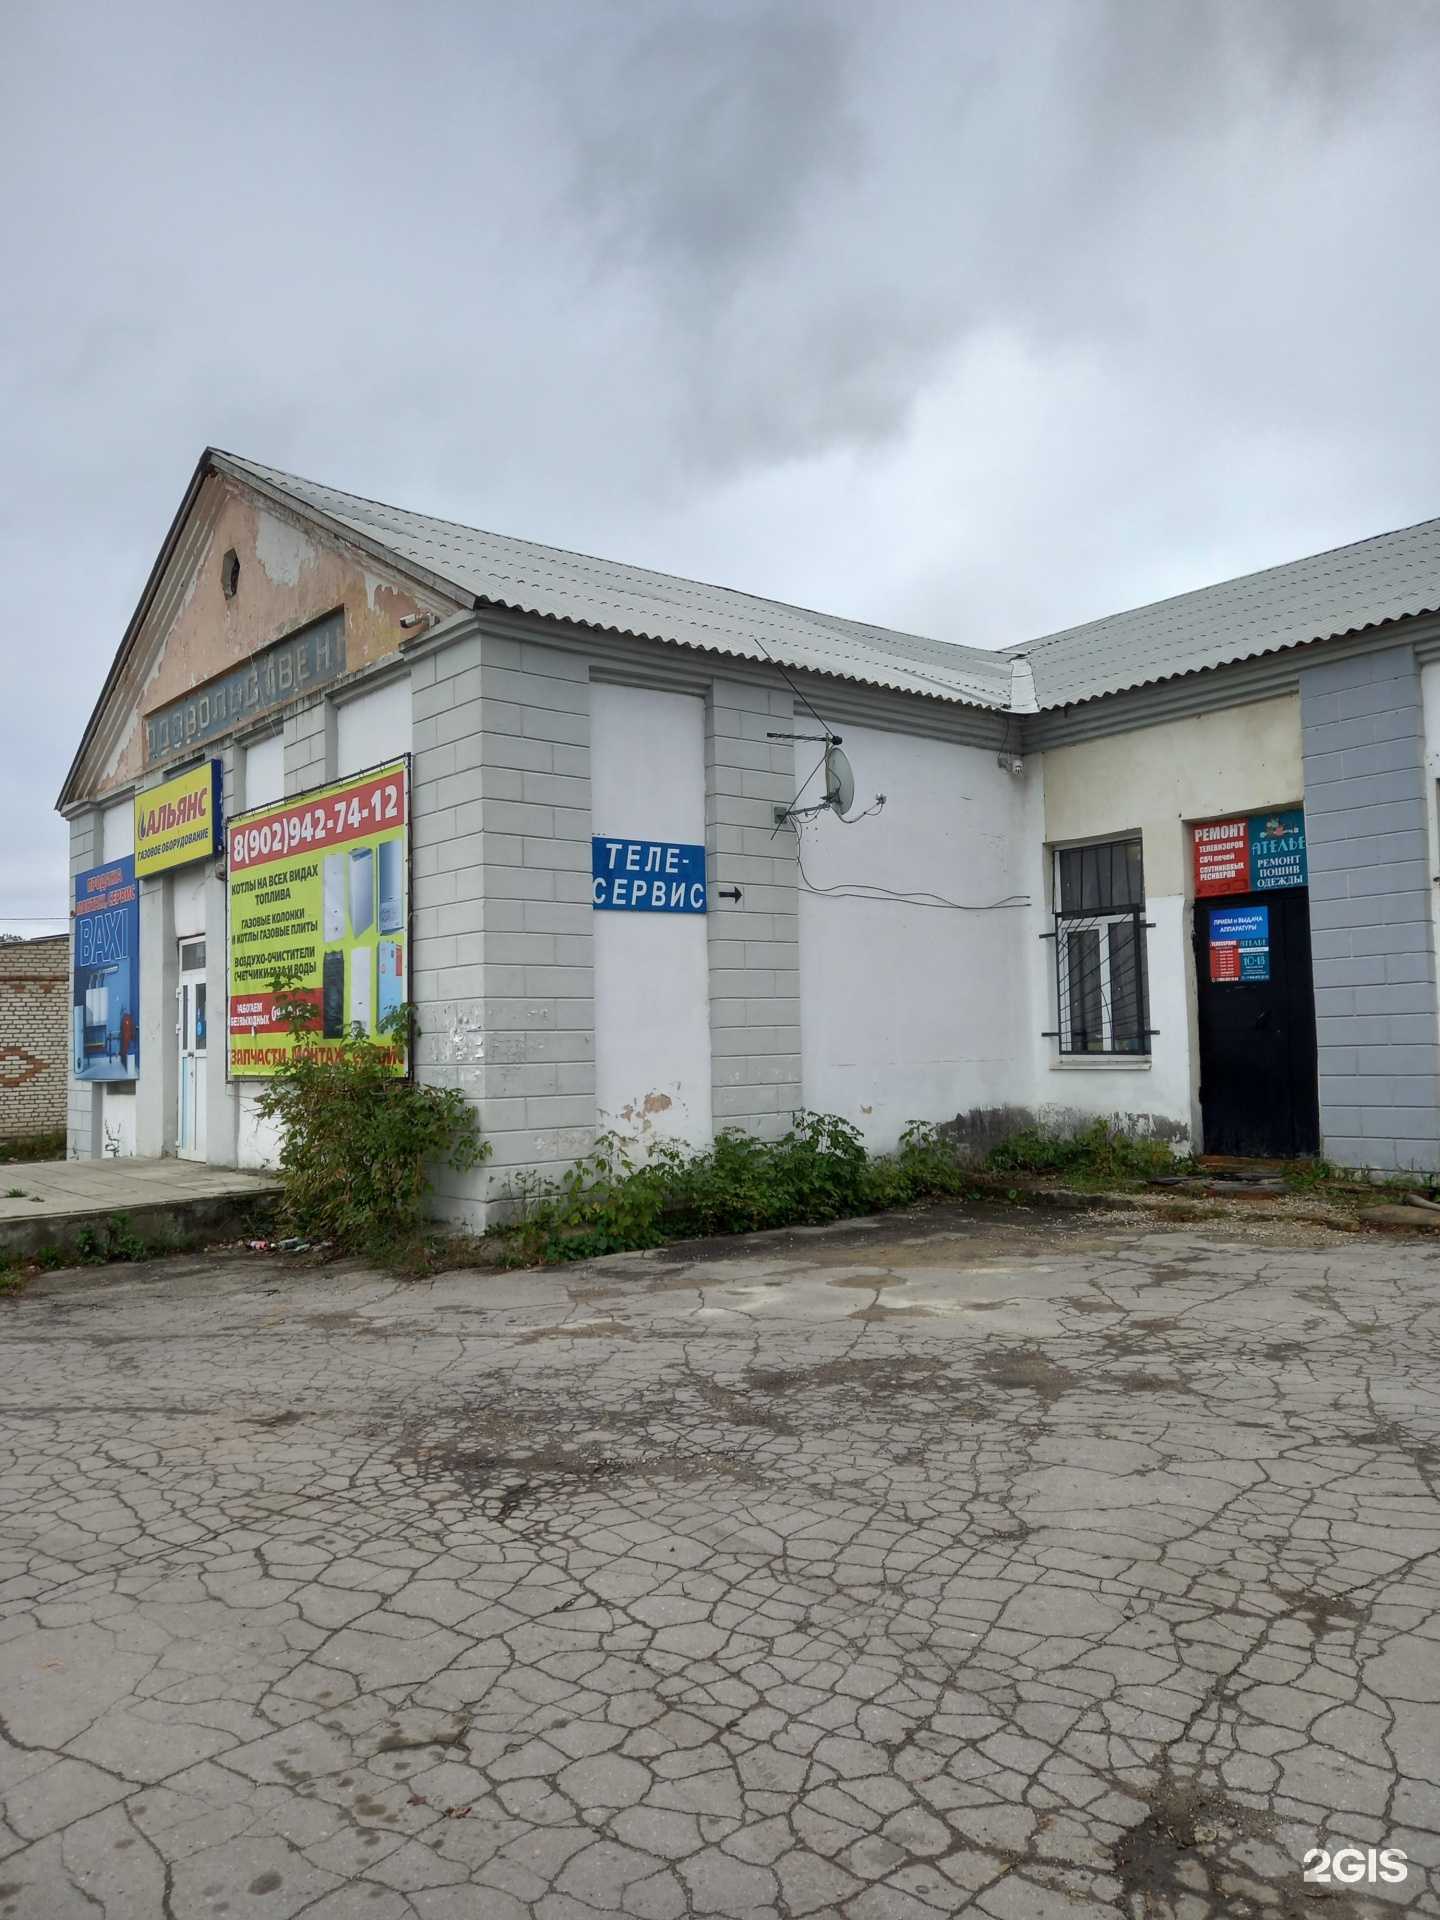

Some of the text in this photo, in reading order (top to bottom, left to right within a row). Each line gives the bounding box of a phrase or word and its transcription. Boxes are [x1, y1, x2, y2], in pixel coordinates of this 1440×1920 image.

[146, 787, 208, 837] АЛЬЯНС
[233, 784, 398, 864] 8(902)942-74-12
[1194, 822, 1246, 842] РЕМОНТ
[137, 828, 209, 861] ГАЗОВОЕ ОБОРУДОВАНИЕ
[1252, 836, 1306, 856] АТЕЛЬЕ
[606, 843, 689, 873] ТЕЛЕ-
[1257, 855, 1301, 867] РЕМОНТ
[232, 864, 319, 896] КОТЛЫ НА ВСЕХ ВИДАХ
[1256, 875, 1303, 889] ОДЕЖДЫ
[1259, 865, 1300, 878] ПОШИВ
[255, 887, 291, 905] ТОПЛИВА
[592, 877, 704, 909] СЕРВИС
[241, 908, 305, 929] ГАЗОВЫЕ КОЛОНКИ
[80, 908, 129, 967] BAXI
[236, 931, 259, 944] КОТЛЫ
[259, 924, 290, 940] ГАЗОВЫЕ
[290, 920, 318, 935] ПЛИТЫ
[234, 946, 316, 968] ВОЗДУХО-ОЧИСТИТЕЛИ
[293, 961, 317, 977] ВОДЫ
